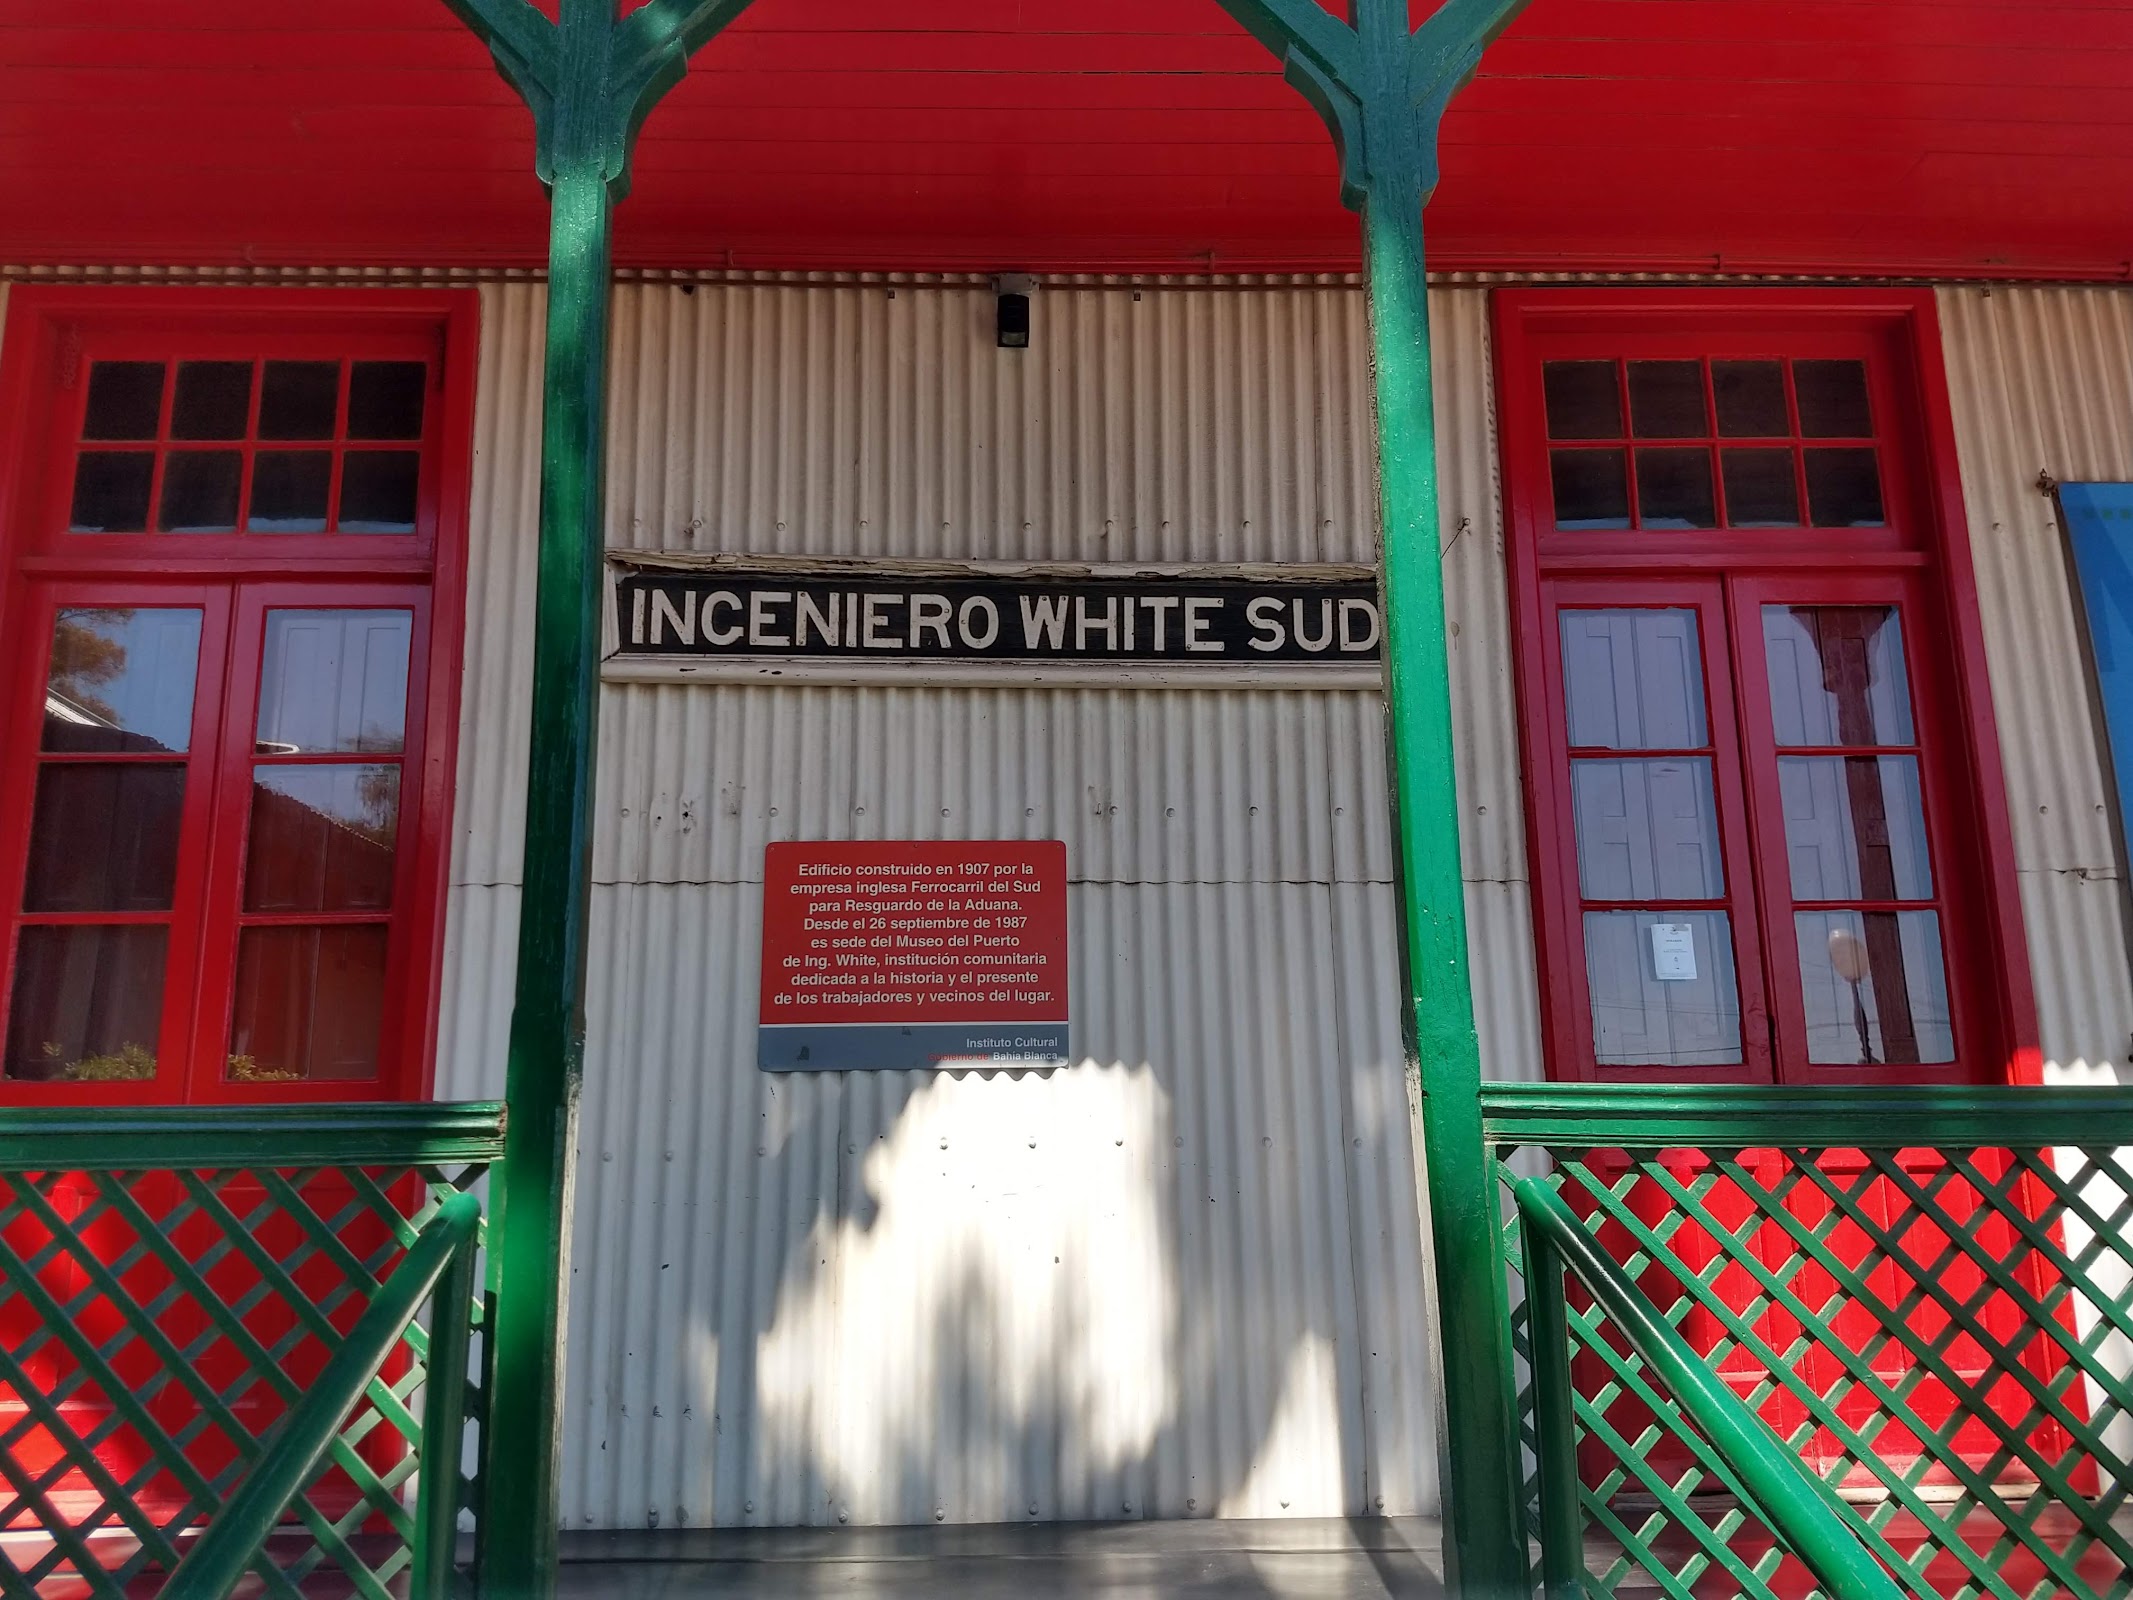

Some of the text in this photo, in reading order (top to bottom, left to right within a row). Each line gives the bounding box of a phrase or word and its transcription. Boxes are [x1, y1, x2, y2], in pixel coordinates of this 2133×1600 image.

[1018, 595, 1225, 652] WHITE
[1245, 596, 1380, 653] SUD
[798, 862, 1034, 878] Edificio construido en 1907 por la
[790, 880, 1041, 897] empresa inglesa Ferrocarril del Sud
[809, 898, 1022, 915] para Resguardo de la Aduana.
[803, 916, 1028, 932] Desde el 26 septiembre de 1987
[810, 934, 1020, 949] es sede del Museo del Puerto
[782, 952, 1047, 970] de Ing. White, institución comunitaria
[790, 971, 1039, 987] dedicada a la historia y el presente
[773, 989, 1055, 1007] de los trabajadores y vecinos del lugar.
[966, 1036, 1058, 1048] Instituto Cultural
[928, 1050, 1058, 1061] Gobierno de Bahía Blanca
